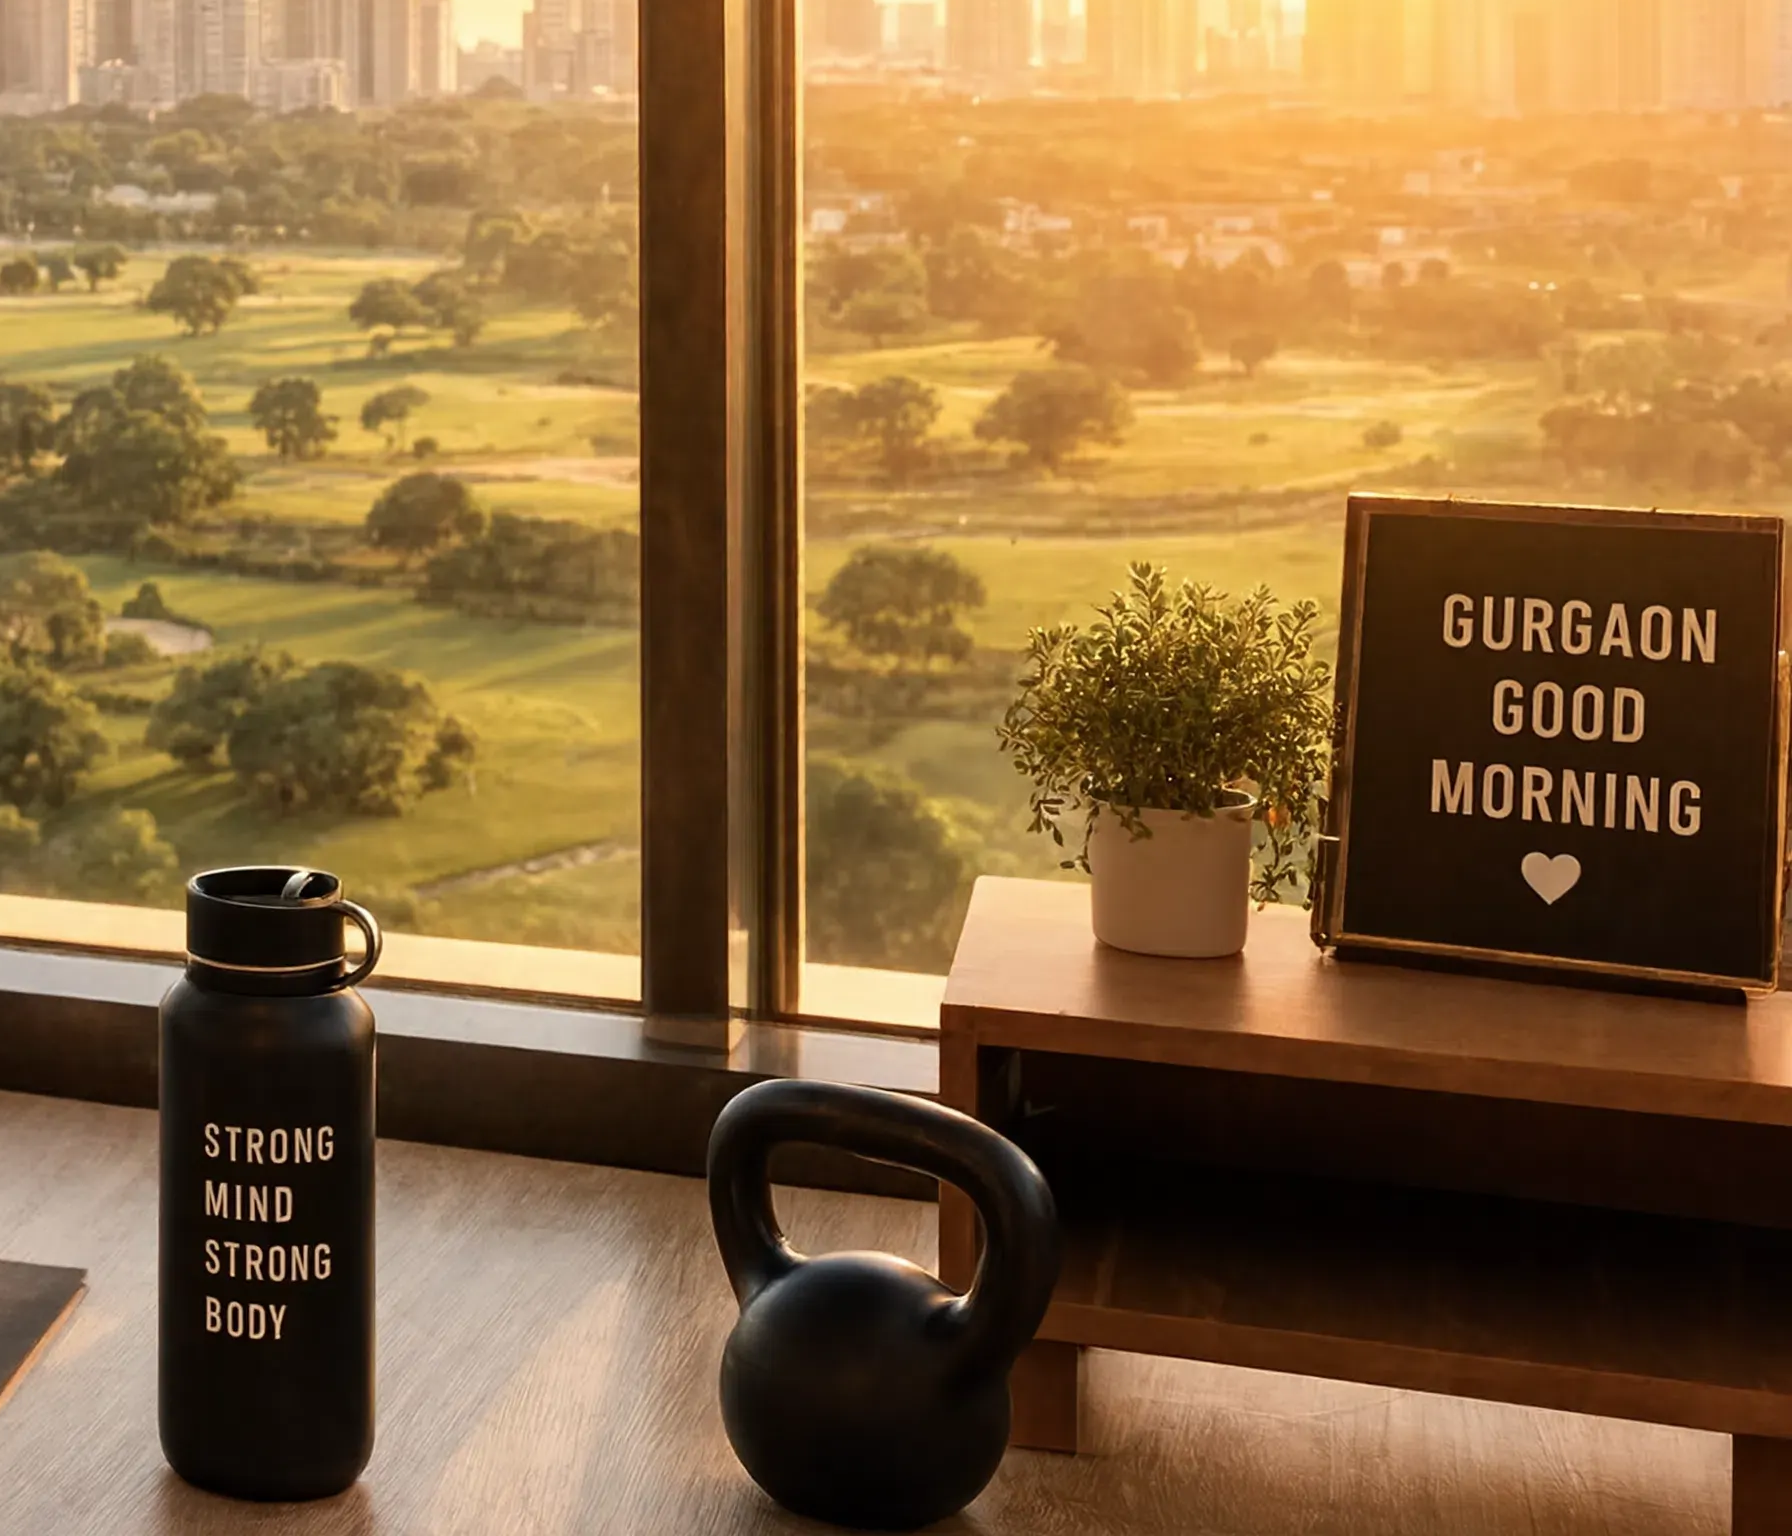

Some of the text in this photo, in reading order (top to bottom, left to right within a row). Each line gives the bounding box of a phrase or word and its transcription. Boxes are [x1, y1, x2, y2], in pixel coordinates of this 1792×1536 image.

[1444, 594, 1716, 663] GURGAON
[1493, 680, 1644, 742] GOOD
[1431, 759, 1700, 835] MORNING
[205, 1123, 333, 1164] STRONG
[206, 1180, 292, 1222] MIND
[206, 1239, 330, 1281] STRONG
[207, 1296, 286, 1339] BODY
